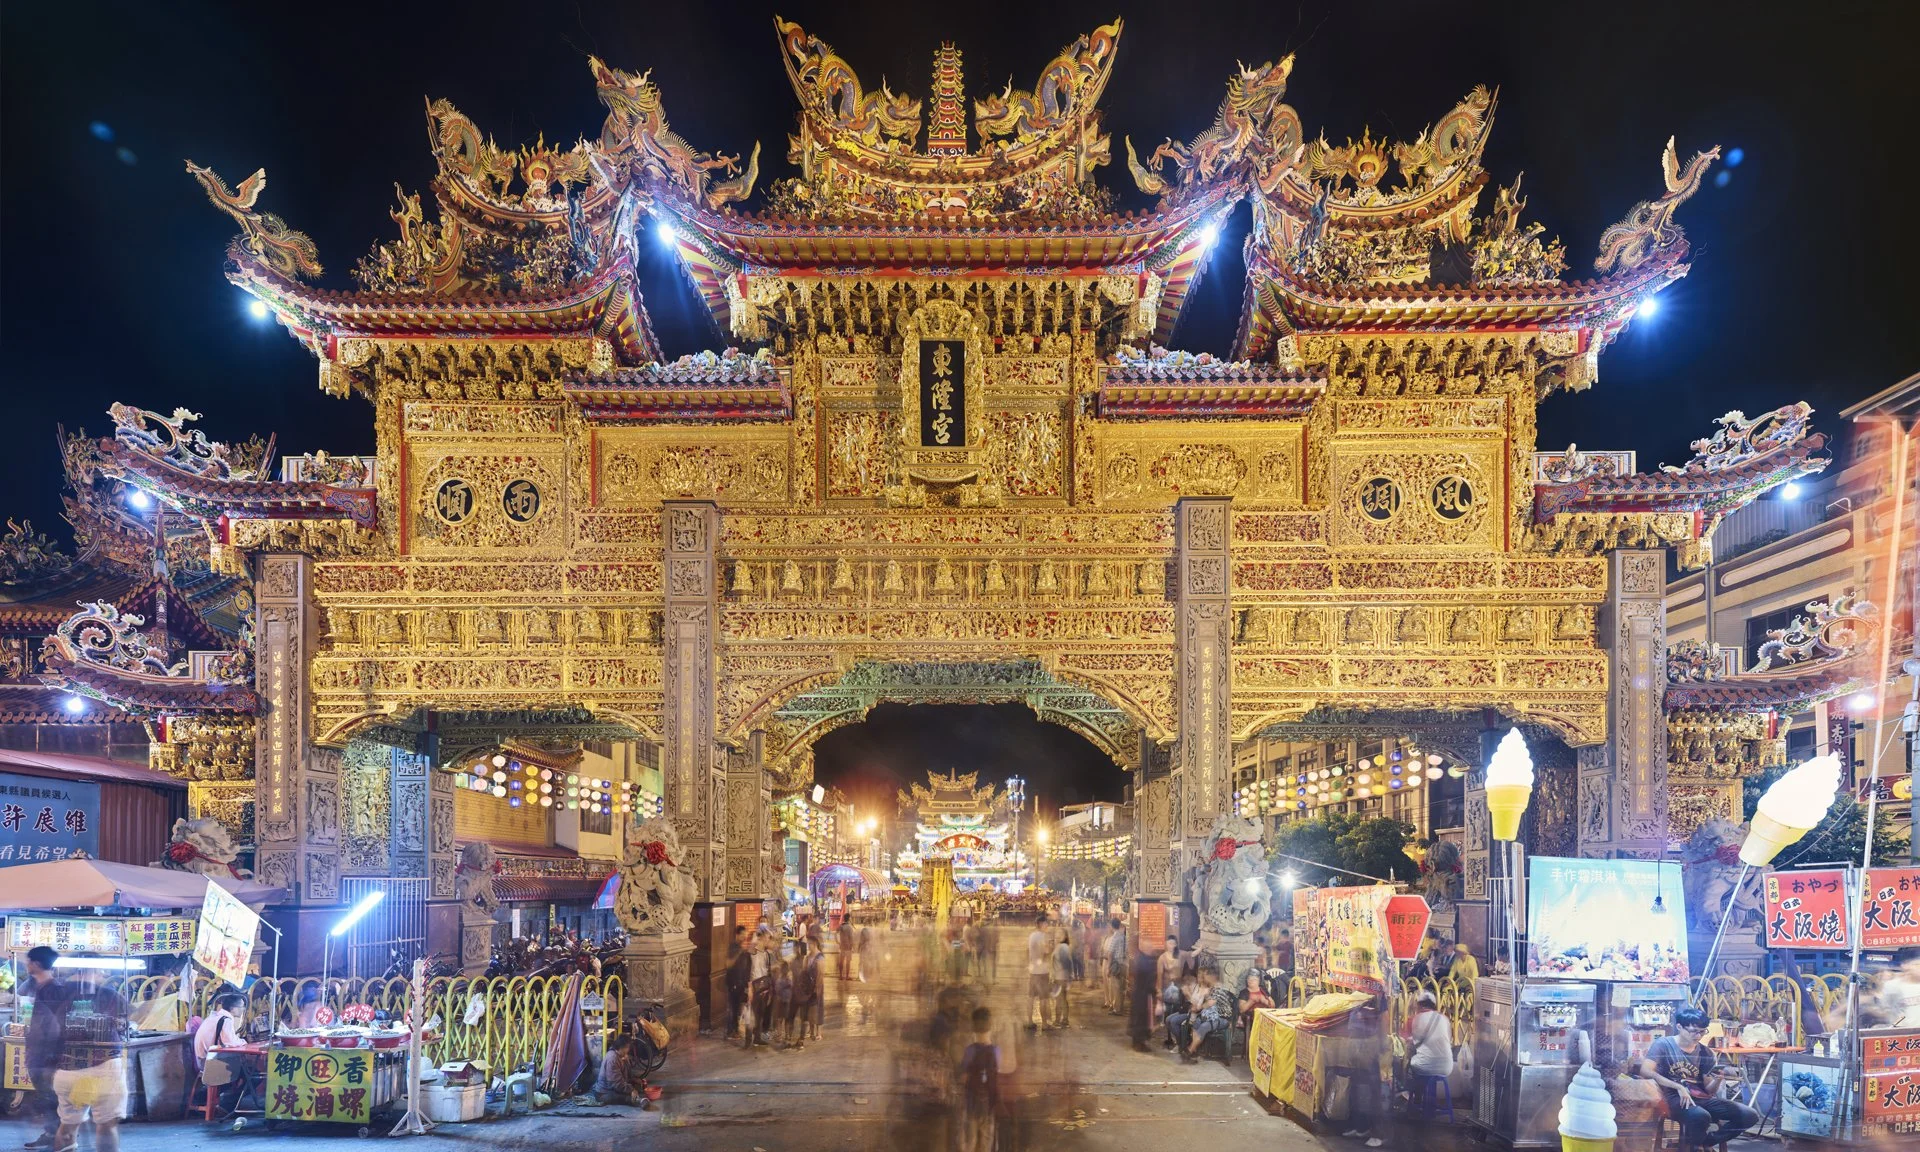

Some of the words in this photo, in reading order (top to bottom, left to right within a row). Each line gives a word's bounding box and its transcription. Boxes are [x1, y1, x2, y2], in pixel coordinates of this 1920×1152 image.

[931, 342, 954, 445] 東隆宮
[440, 483, 468, 520] 順
[505, 482, 537, 519] 雨
[1361, 481, 1396, 517] 調
[1434, 478, 1471, 513] 風
[1, 803, 88, 837] 許展維
[0, 845, 68, 861] 看見希望
[1551, 868, 1618, 884] 手作霜淇淋
[1769, 881, 1779, 900] 京都
[1783, 900, 1801, 910] 日式
[1879, 888, 1896, 900] 日式
[1771, 909, 1844, 943] 大阪燒
[1864, 900, 1920, 930] 大阪
[169, 922, 180, 950] 冬瓜茶
[181, 921, 192, 949] 甘蔗汁
[270, 1084, 367, 1120] 燒酒螺
